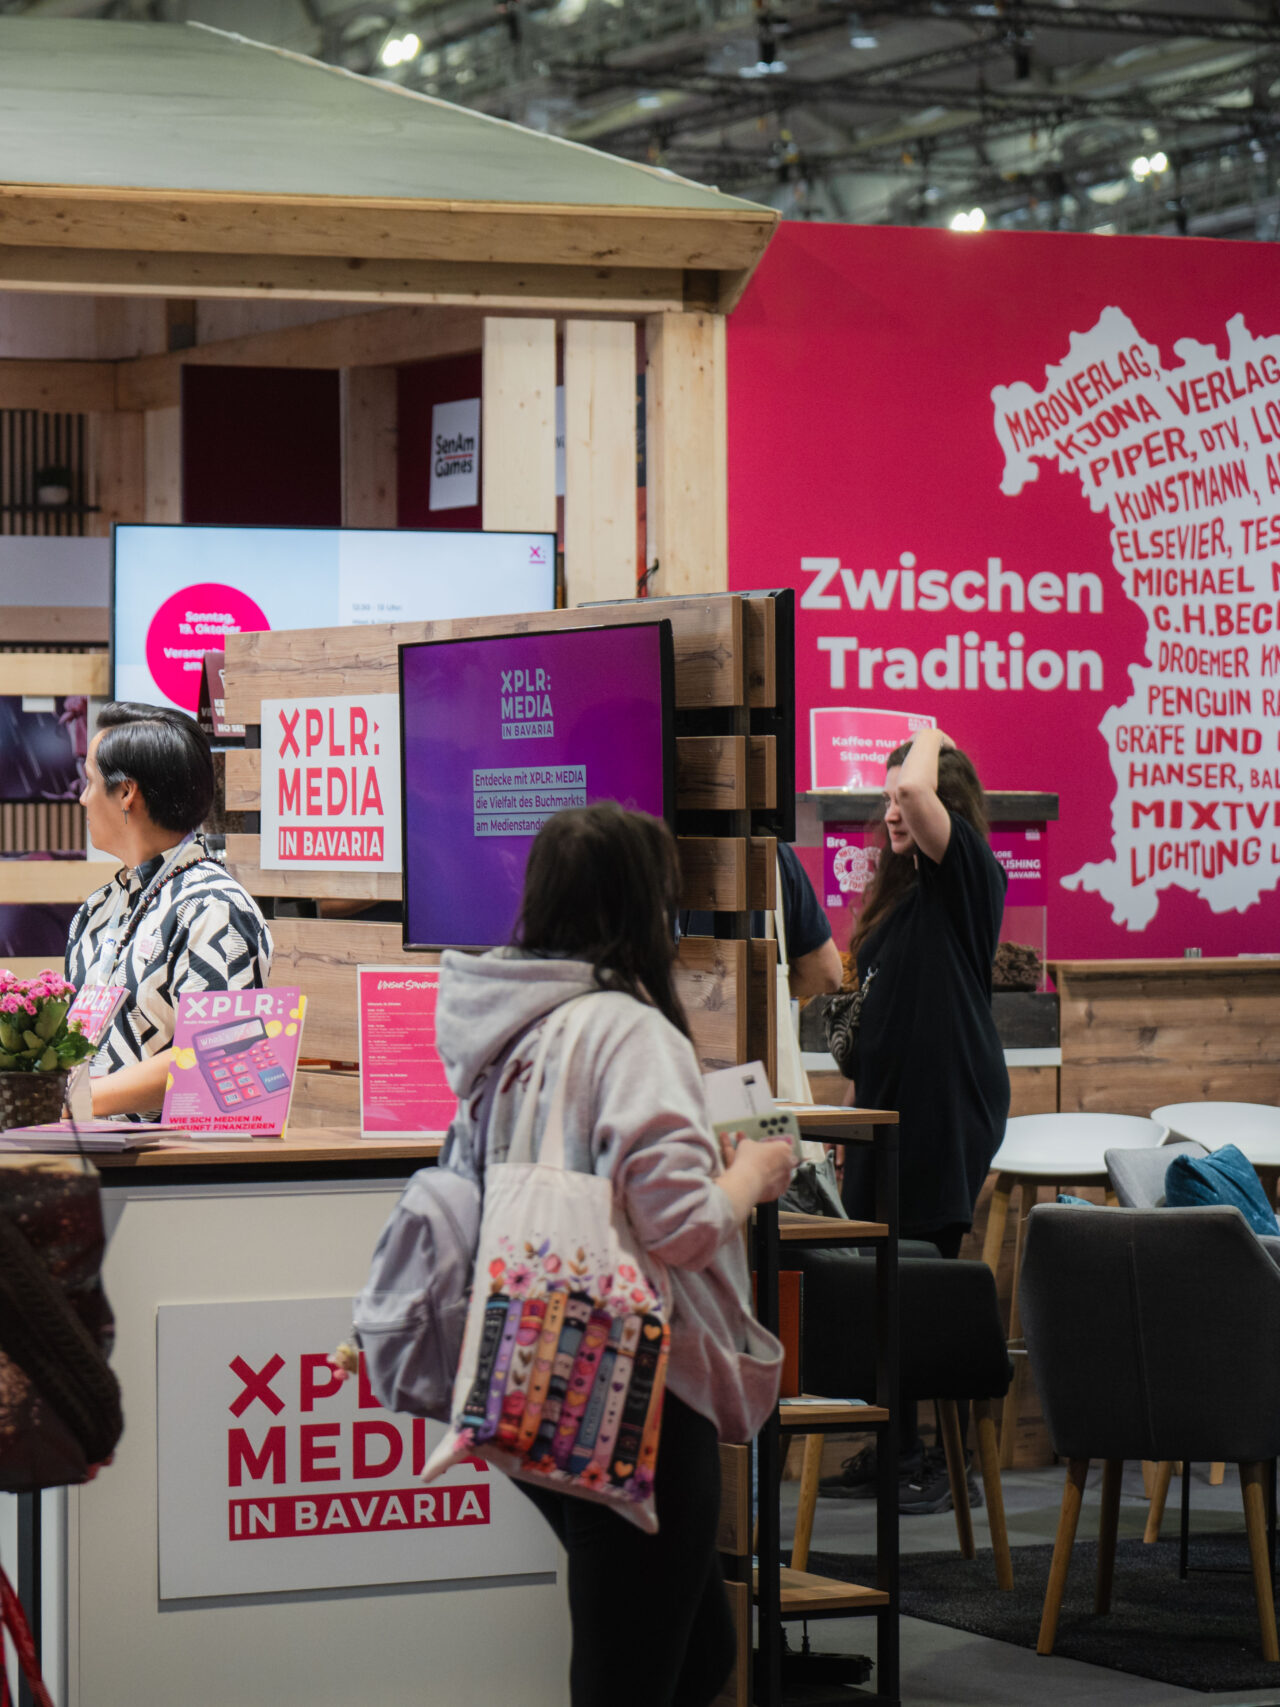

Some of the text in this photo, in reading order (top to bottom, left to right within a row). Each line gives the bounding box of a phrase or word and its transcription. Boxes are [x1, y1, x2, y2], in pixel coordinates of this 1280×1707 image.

[1004, 343, 1161, 453] MAROVERLAG,
[1054, 393, 1162, 460] KJONA
[435, 432, 475, 456] SenAm
[1089, 427, 1198, 488] PIPER,
[1199, 415, 1249, 453] DTV,
[434, 458, 473, 479] Games
[1114, 458, 1261, 525] KUNSTMANN,
[1116, 516, 1233, 563] ELSEVIER,
[800, 551, 1104, 613] Zwischen
[1132, 564, 1256, 598] MICHAEL
[195, 623, 242, 636] Oktober
[1152, 602, 1280, 637] C.H.BEC
[817, 630, 1104, 692] Tradition
[1158, 640, 1251, 679] DROEMER
[500, 668, 552, 695] XPLR:
[500, 694, 554, 720] MEDIA
[1147, 685, 1252, 718] PENGUIN
[278, 706, 380, 759] XPLR:
[502, 723, 553, 738] IN BAVARIA
[831, 736, 873, 748] Kaffee
[1116, 724, 1263, 756] GRÄFE UND
[840, 751, 889, 764] Standg
[278, 765, 385, 817] MEDIA
[475, 769, 584, 787] Entdecke mit XPLR: MEDIA
[1128, 762, 1244, 795] HANSER,
[475, 794, 585, 809] die Vielfalt des Buchmarkts
[476, 821, 489, 832] am
[280, 831, 382, 857] IN BAVARIA
[1001, 859, 1042, 870] LISHING
[1130, 836, 1262, 888] LICHTUNG
[184, 992, 285, 1019] XPLR:
[169, 1114, 262, 1125] WIE SICH MEDIEN IN
[213, 1121, 276, 1131] FINANZIEREN
[228, 1352, 384, 1419] XPL
[228, 1417, 490, 1487] MEDI
[233, 1490, 485, 1536] IN BAVARIA
